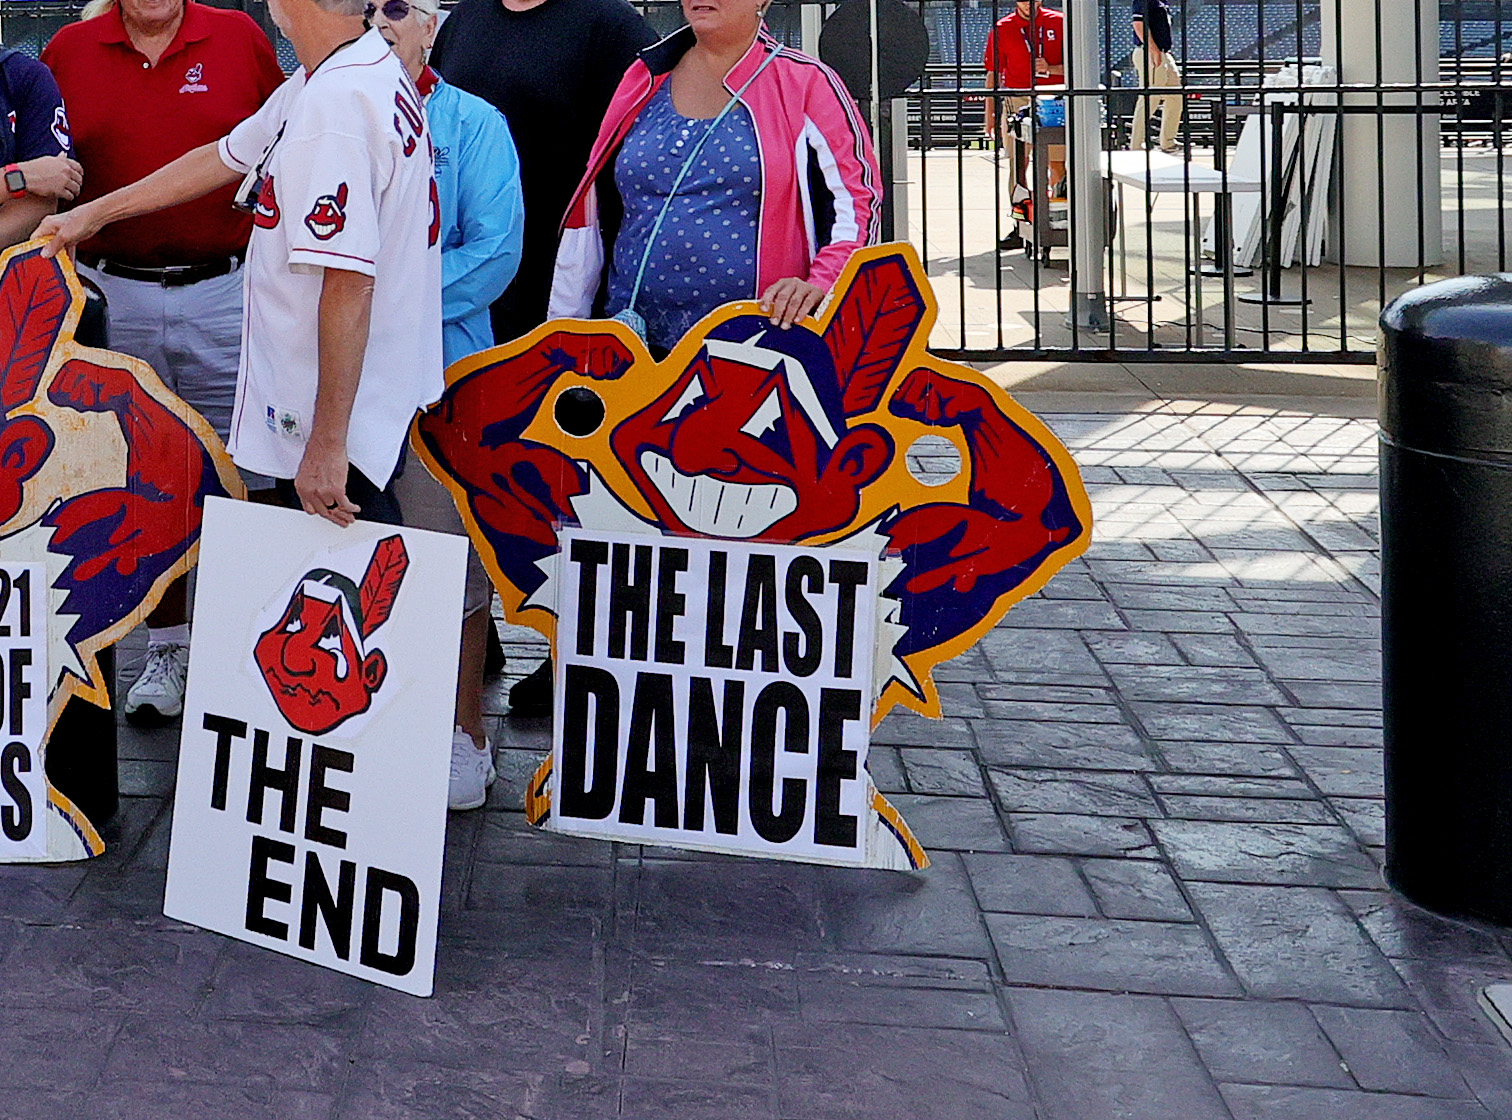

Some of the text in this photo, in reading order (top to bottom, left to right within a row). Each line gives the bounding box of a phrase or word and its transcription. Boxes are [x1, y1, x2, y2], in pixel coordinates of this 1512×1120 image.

[570, 538, 869, 678] THE LAST
[202, 712, 355, 850] THE
[559, 663, 862, 848] DANCE
[244, 835, 420, 977] END
